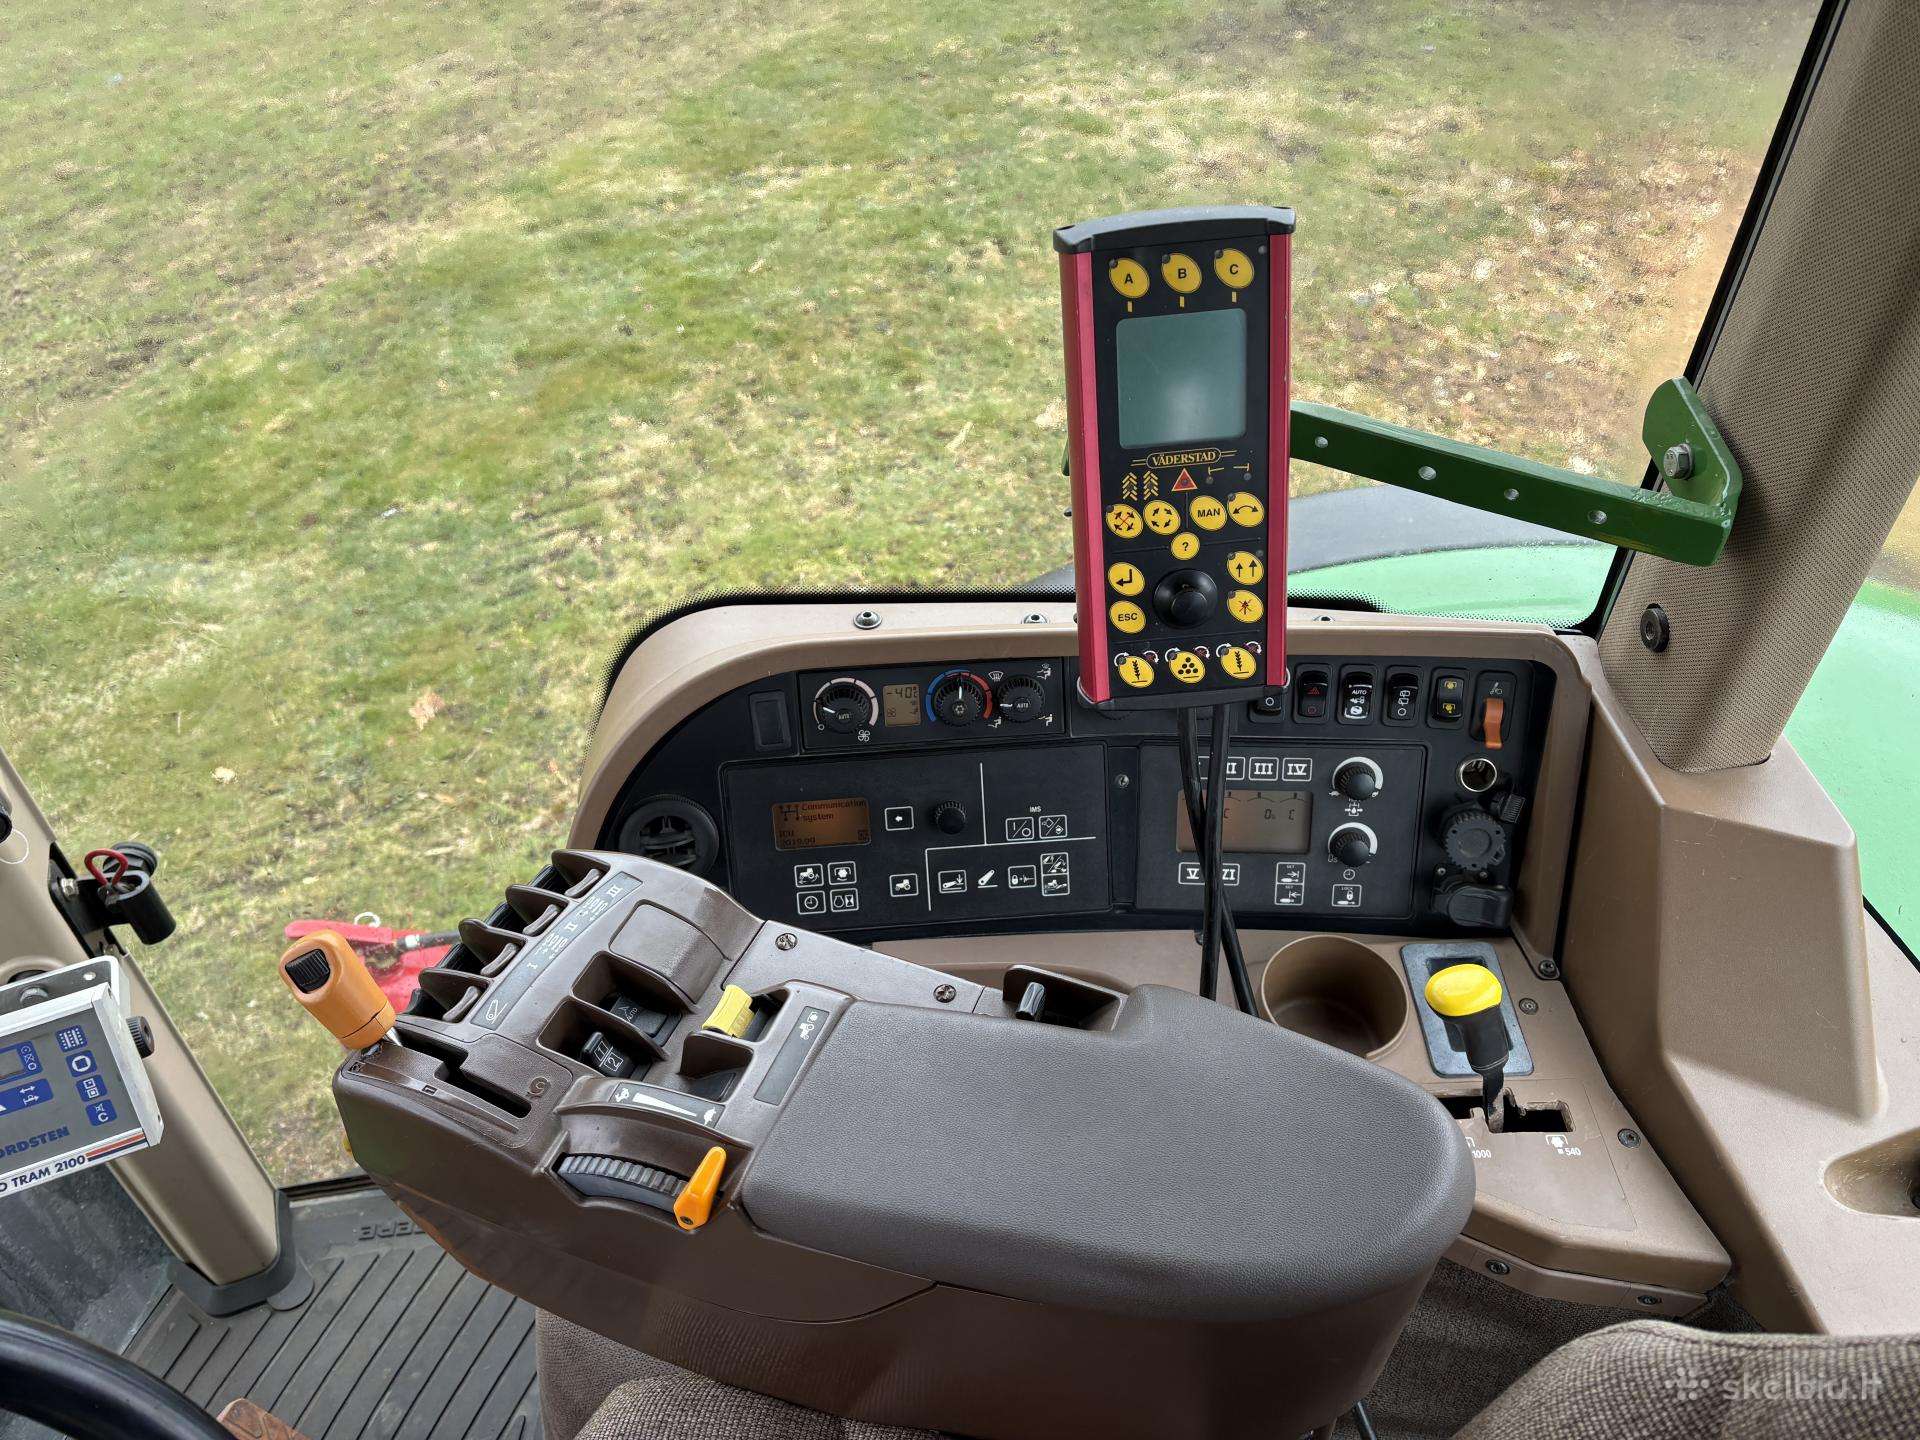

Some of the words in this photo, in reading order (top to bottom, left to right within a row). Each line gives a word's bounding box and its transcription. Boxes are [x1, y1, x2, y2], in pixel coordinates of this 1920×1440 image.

[1177, 268, 1187, 279] B
[1229, 263, 1239, 275] C
[1124, 273, 1134, 284] A
[1152, 451, 1216, 466] VÄDERSTAD
[1197, 508, 1221, 518] MAN
[1117, 612, 1138, 622] ESC
[1254, 762, 1274, 775] III
[1287, 763, 1308, 776] IV
[1186, 868, 1200, 880] V
[97, 1112, 109, 1122] C
[1472, 1149, 1492, 1158] 1000
[1565, 1147, 1582, 1156] 540
[11, 1167, 51, 1188] TRAM
[55, 1155, 86, 1173] 2100
